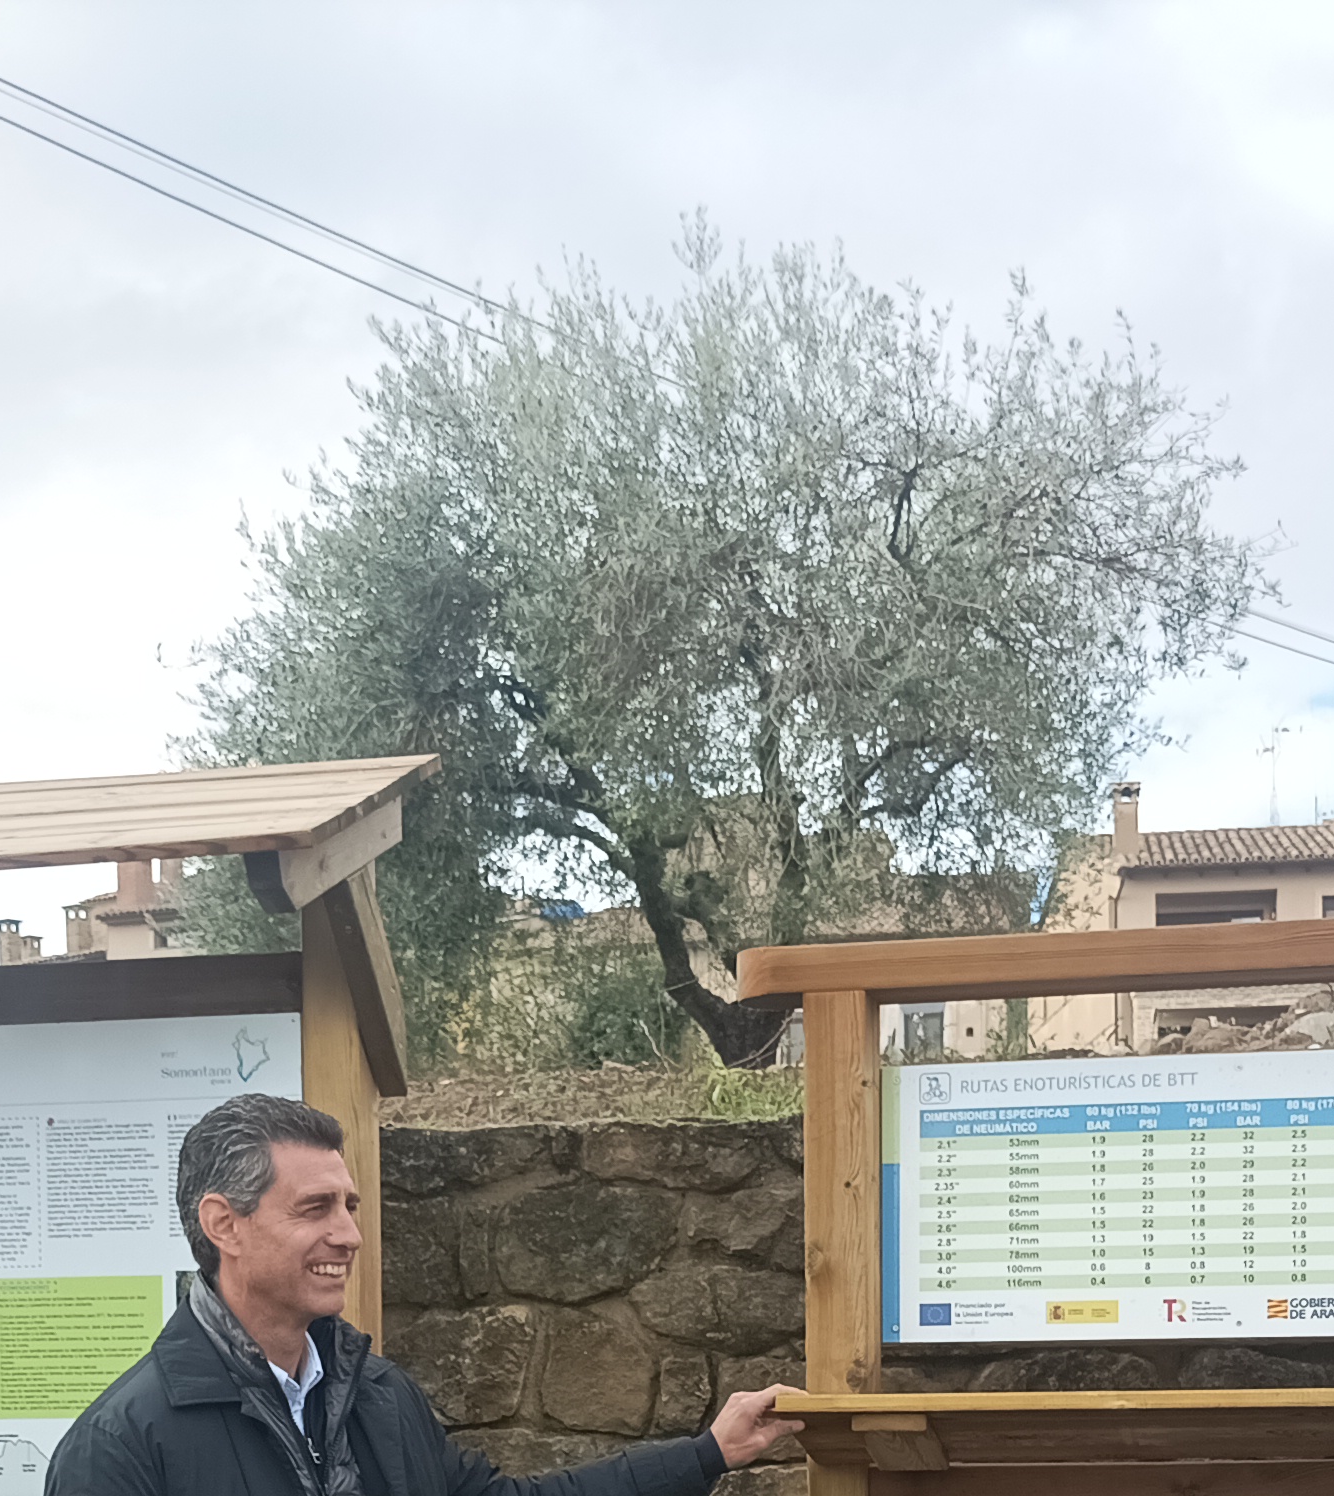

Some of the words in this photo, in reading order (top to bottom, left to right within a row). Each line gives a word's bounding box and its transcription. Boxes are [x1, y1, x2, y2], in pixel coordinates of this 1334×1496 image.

[161, 1066, 231, 1079] Somontano
[961, 1080, 1008, 1093] RUTAS
[1014, 1073, 1136, 1091] ENOTURÍSTICAS
[1142, 1073, 1162, 1087] DE
[1167, 1072, 1198, 1086] BTT
[1086, 1106, 1099, 1116] 60
[1102, 1106, 1114, 1118] kg
[1116, 1105, 1138, 1117] (132
[1141, 1104, 1161, 1117] lbs)
[1186, 1103, 1198, 1112] 70
[1200, 1102, 1214, 1114] kg
[1216, 1102, 1238, 1113] (154
[1240, 1101, 1261, 1112] lbs)
[1286, 1100, 1299, 1110] 80
[1302, 1100, 1315, 1112] kg
[924, 1110, 995, 1122] DIMENSIONES
[999, 1107, 1069, 1120] ESPECÍFICAS
[956, 1124, 970, 1135] DE
[973, 1121, 1037, 1134] NEUMÁTICO
[1087, 1120, 1110, 1131] BAR
[1139, 1119, 1157, 1130] PSI
[1189, 1118, 1207, 1127] PSI
[1236, 1116, 1261, 1126] BAR
[1290, 1115, 1308, 1124] PSI
[1009, 1138, 1039, 1147] 53mm
[1092, 1136, 1105, 1144] 1.9
[1142, 1134, 1154, 1143] 28
[1191, 1133, 1205, 1141] 2.2
[1243, 1131, 1254, 1140] 32
[1292, 1130, 1307, 1138] 2.5
[1009, 1167, 1039, 1175] 58mm
[1092, 1164, 1105, 1172] 1.8
[1142, 1162, 1154, 1171] 26
[1191, 1161, 1205, 1170] 2.0
[1243, 1160, 1254, 1168] 29
[1292, 1158, 1306, 1167] 2.2
[1009, 1194, 1039, 1203] 62mm
[1092, 1192, 1105, 1200] 1.6
[1142, 1191, 1154, 1199] 23
[1192, 1190, 1205, 1198] 1.9
[1243, 1189, 1254, 1197] 28
[1292, 1187, 1305, 1196] 2.1
[1009, 1222, 1039, 1231] 66mm
[1092, 1221, 1105, 1229] 1.5
[1142, 1219, 1153, 1228] 22
[1192, 1218, 1205, 1226] 1.8
[1243, 1217, 1254, 1226] 26
[1292, 1216, 1306, 1224] 2.0
[1009, 1251, 1039, 1259] 78mm
[1092, 1249, 1105, 1257] 1.0
[1143, 1248, 1154, 1256] 15
[1192, 1247, 1205, 1255] 1.3
[1244, 1246, 1254, 1254] 19
[1293, 1244, 1306, 1253] 1.5
[1007, 1279, 1041, 1287] 116mm
[1091, 1277, 1105, 1286] 0.4
[1190, 1275, 1205, 1284] 0.7
[1243, 1274, 1254, 1283] 10
[1291, 1273, 1306, 1282] 0.8
[1289, 1308, 1306, 1319] DE
